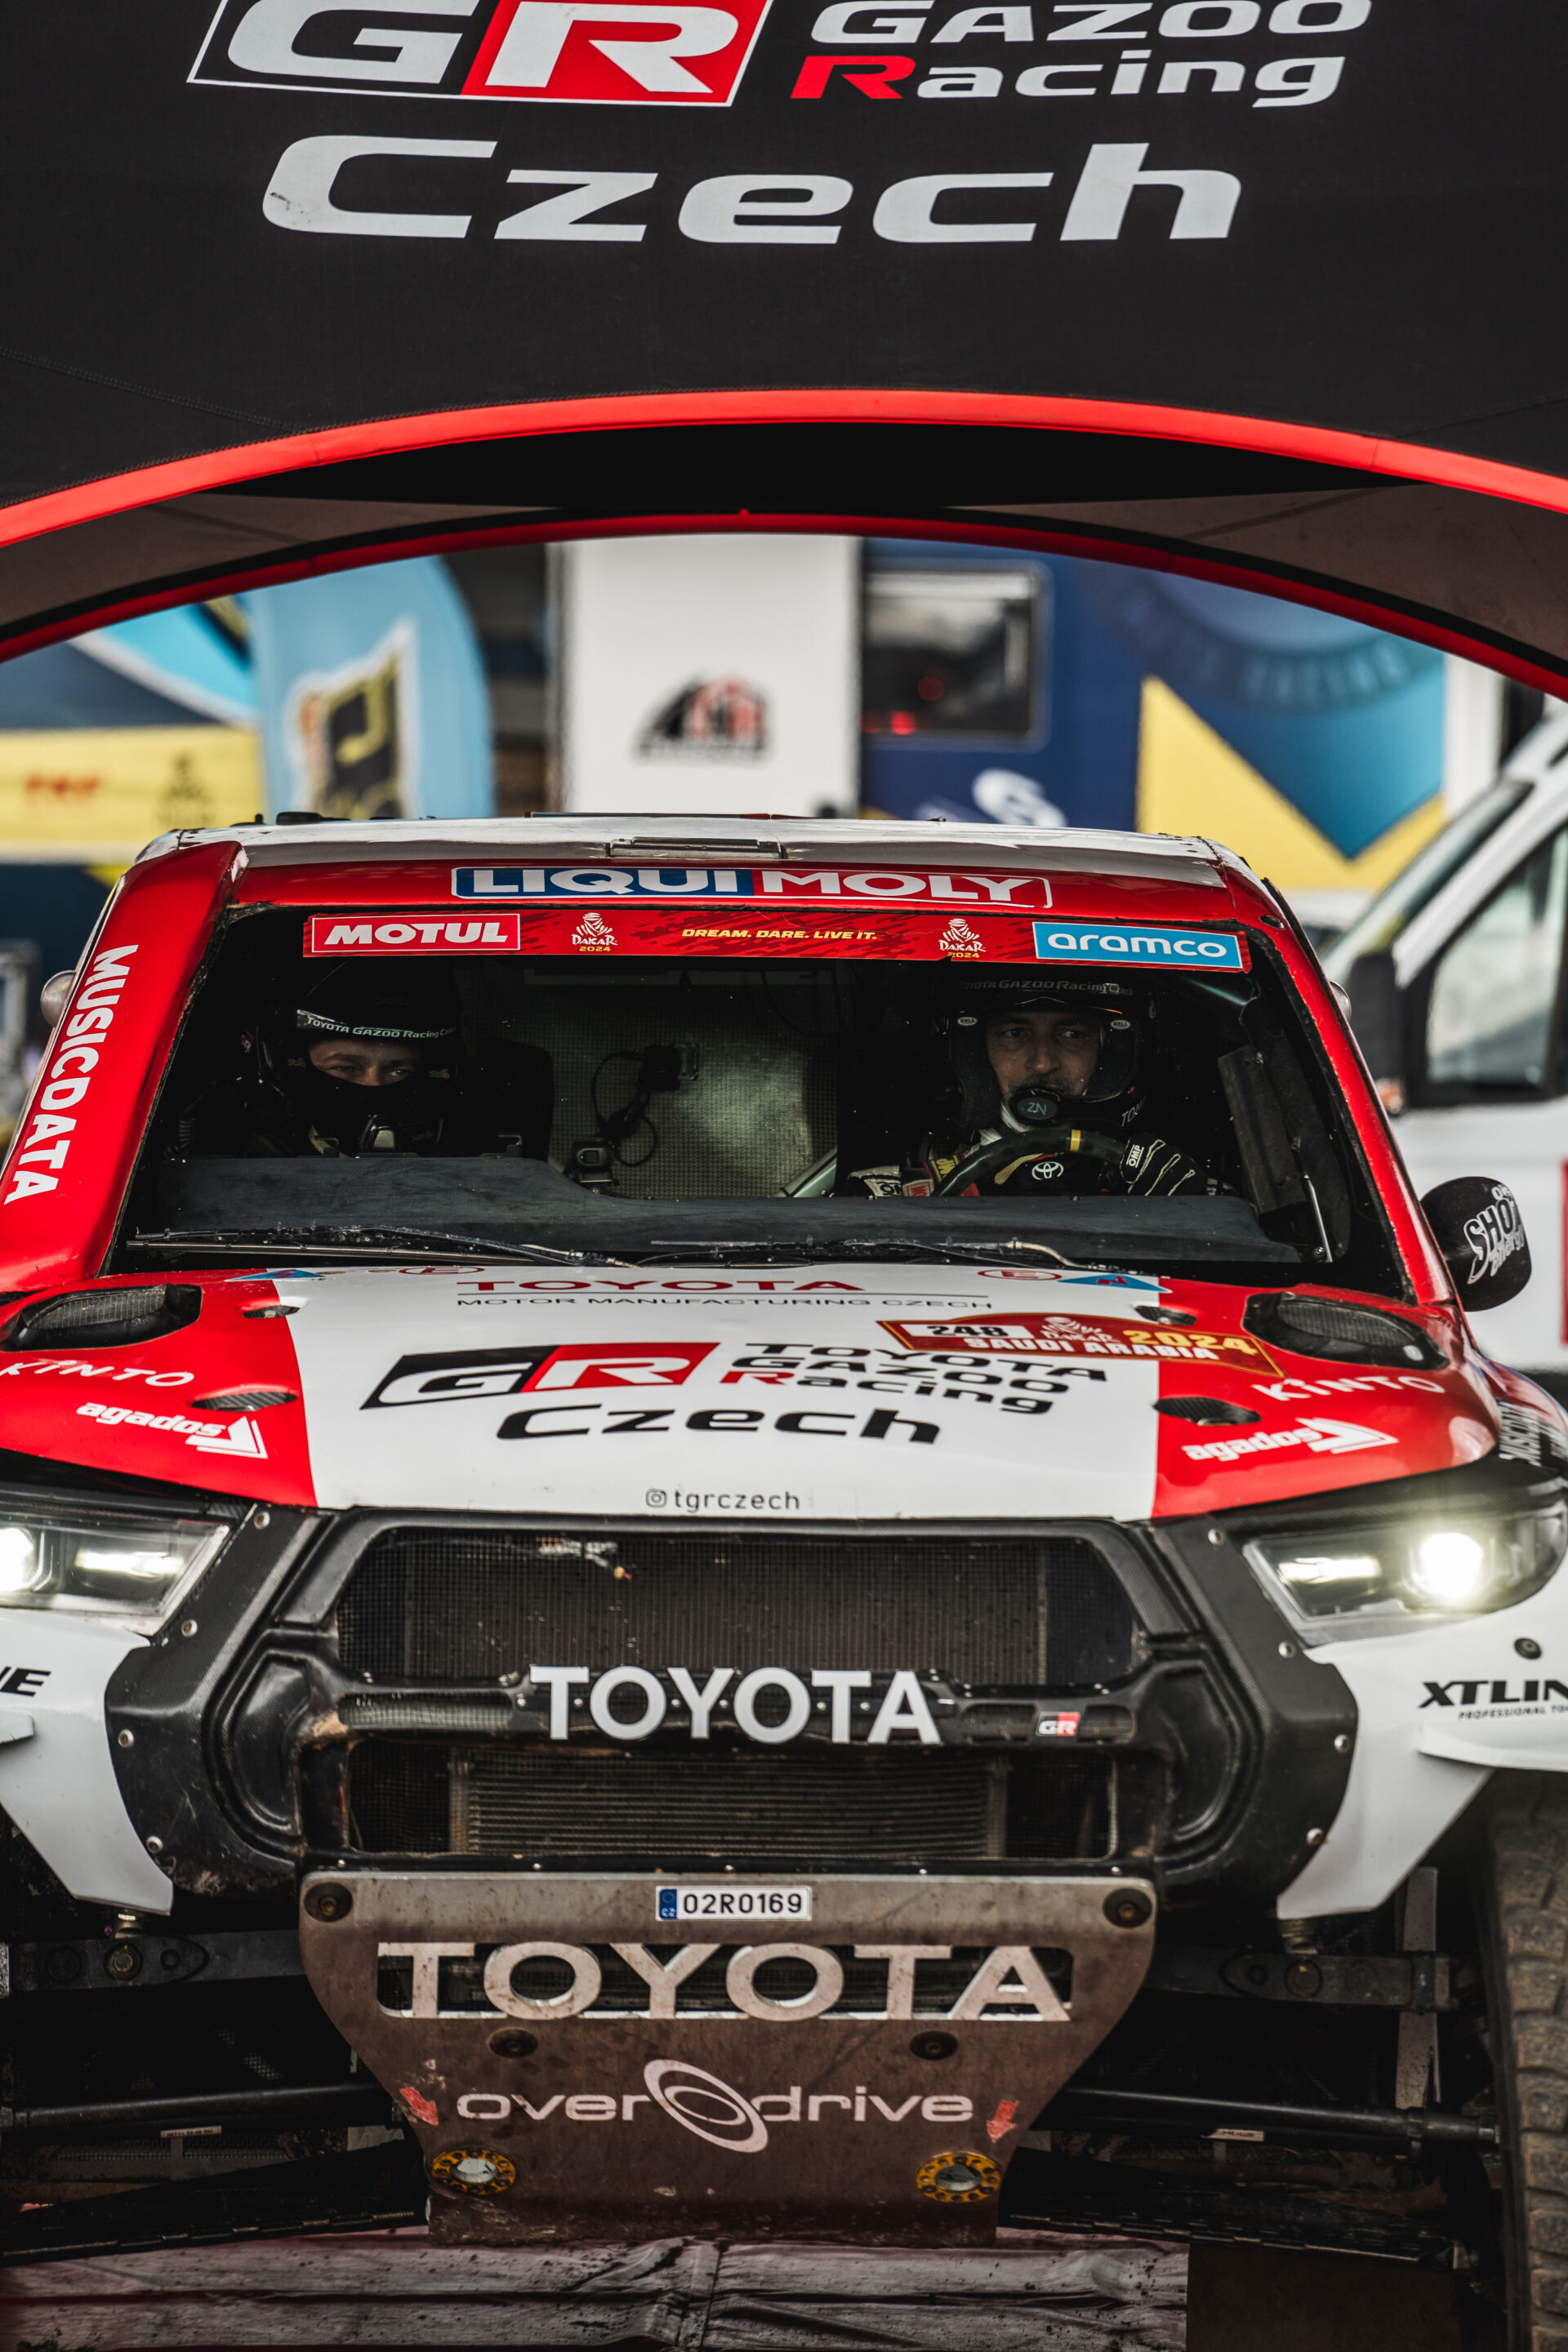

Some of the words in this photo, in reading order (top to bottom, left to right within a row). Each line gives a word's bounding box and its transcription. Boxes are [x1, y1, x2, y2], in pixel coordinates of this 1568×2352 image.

[810, 0, 1372, 43] GAZOO
[228, 0, 739, 93] GR
[790, 49, 1346, 108] Racing
[262, 135, 1242, 244] Czech
[474, 868, 738, 895] LIQUI
[761, 871, 1035, 902] MOLY
[324, 922, 509, 946] MOTUL
[572, 934, 618, 946] DAKAR
[682, 929, 751, 938] DREAM.
[755, 930, 809, 938] DARE.
[813, 930, 852, 939] LIVE
[857, 931, 878, 940] IT.
[938, 939, 987, 952] DAKAR
[1047, 933, 1226, 958] aramco
[998, 980, 1054, 989] GAZOO
[1057, 981, 1107, 994] Racing
[306, 1016, 350, 1034] TOYOTA
[352, 1027, 401, 1039] GAZOO
[403, 1030, 439, 1040] Racing
[4, 944, 139, 1205] MUSICDATA
[1128, 1145, 1142, 1167] OMP
[457, 1281, 865, 1291] TOYOTA
[882, 1299, 991, 1308] CZECH
[927, 1325, 1009, 1337] 248
[1123, 1330, 1258, 1356] 2024
[963, 1339, 1075, 1352] SAUDI
[1083, 1342, 1220, 1360] ARABIA
[732, 1356, 1070, 1393] GAZOO
[746, 1343, 1107, 1382] TOYOTA
[378, 1357, 692, 1404] GR
[719, 1371, 1054, 1415] Racing
[77, 1402, 227, 1437] agados
[497, 1404, 941, 1445] Czech
[1182, 1427, 1323, 1461] agados
[675, 1490, 800, 1512] tgrczech
[529, 1664, 942, 1744] TOYOTA
[1458, 1705, 1546, 1720] PROFESSIONAL
[1038, 1720, 1077, 1735] GR
[684, 1894, 802, 1914] 02R0169
[377, 1941, 1071, 2021] TOYOTA
